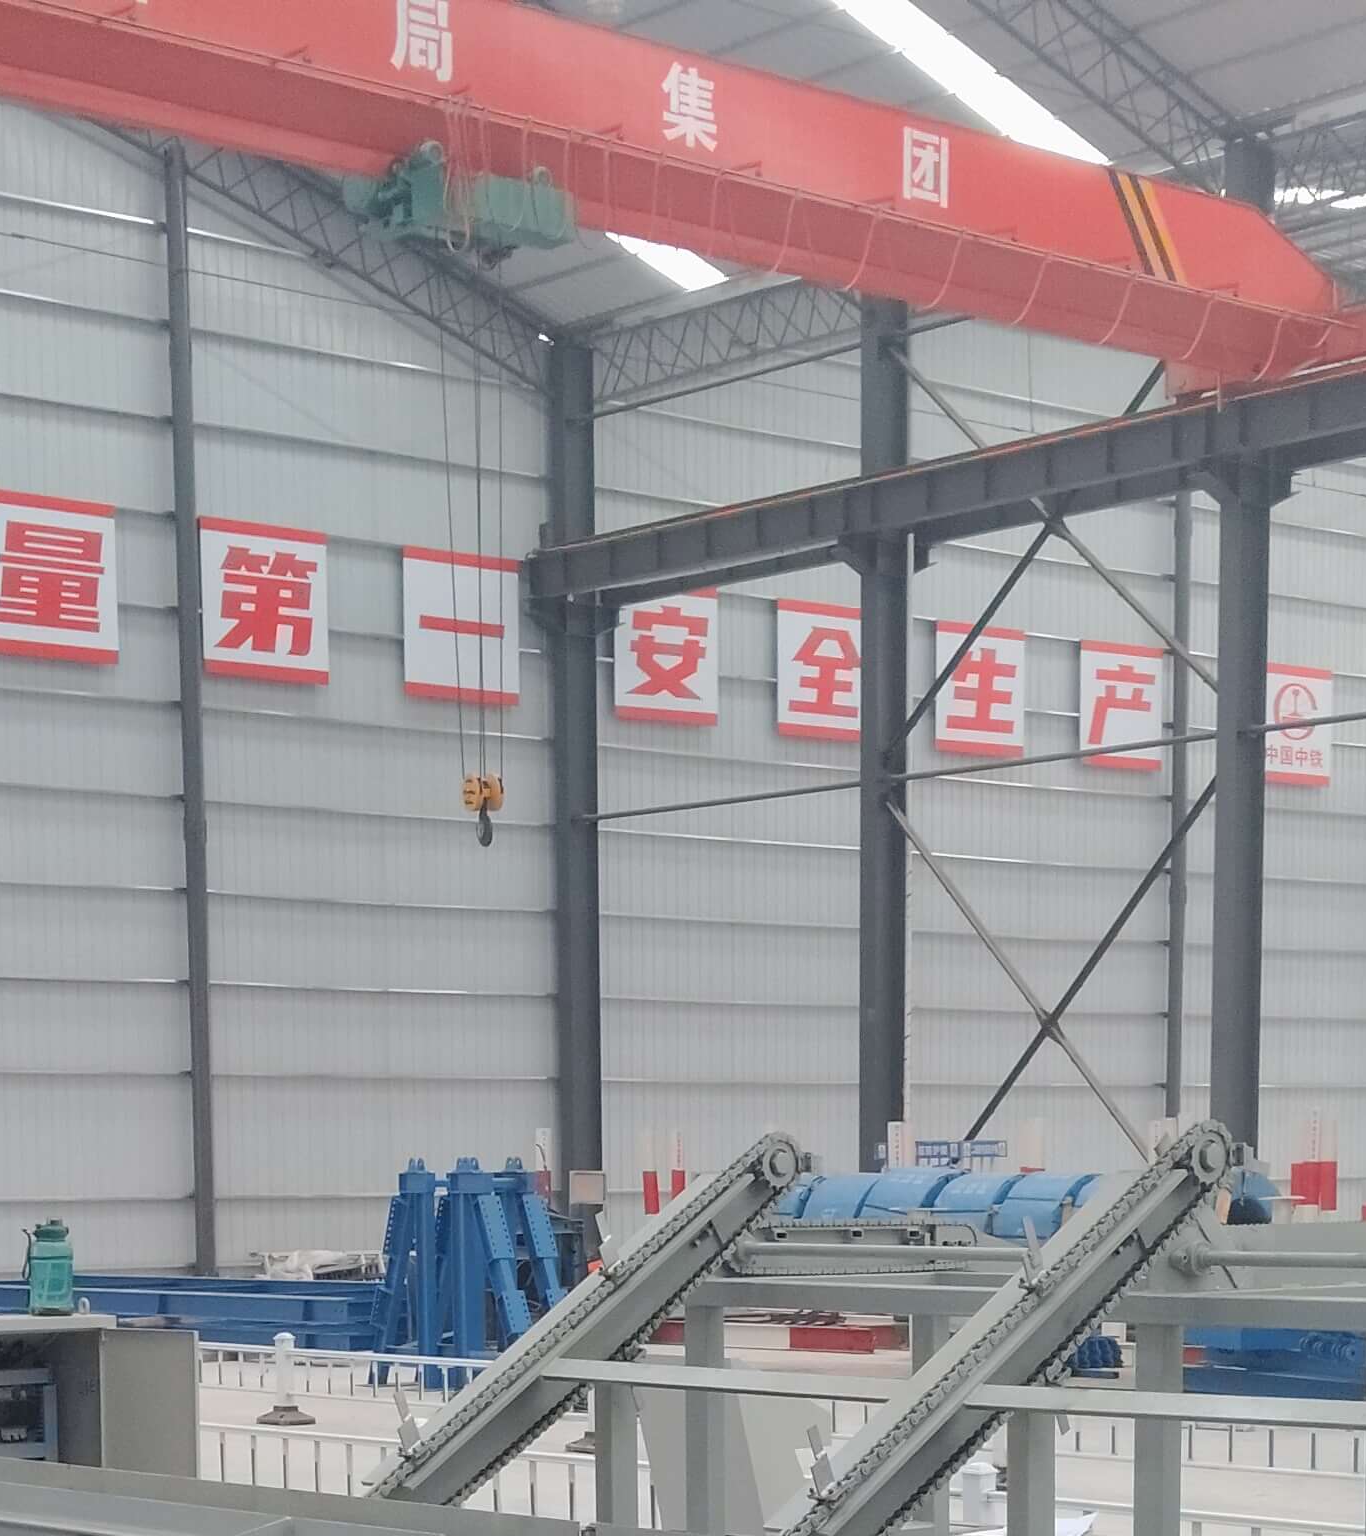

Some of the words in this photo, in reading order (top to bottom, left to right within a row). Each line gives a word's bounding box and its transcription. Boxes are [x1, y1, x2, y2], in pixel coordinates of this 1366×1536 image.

[626, 604, 1157, 746] 安全生产
[1266, 744, 1323, 769] 中国中铁
